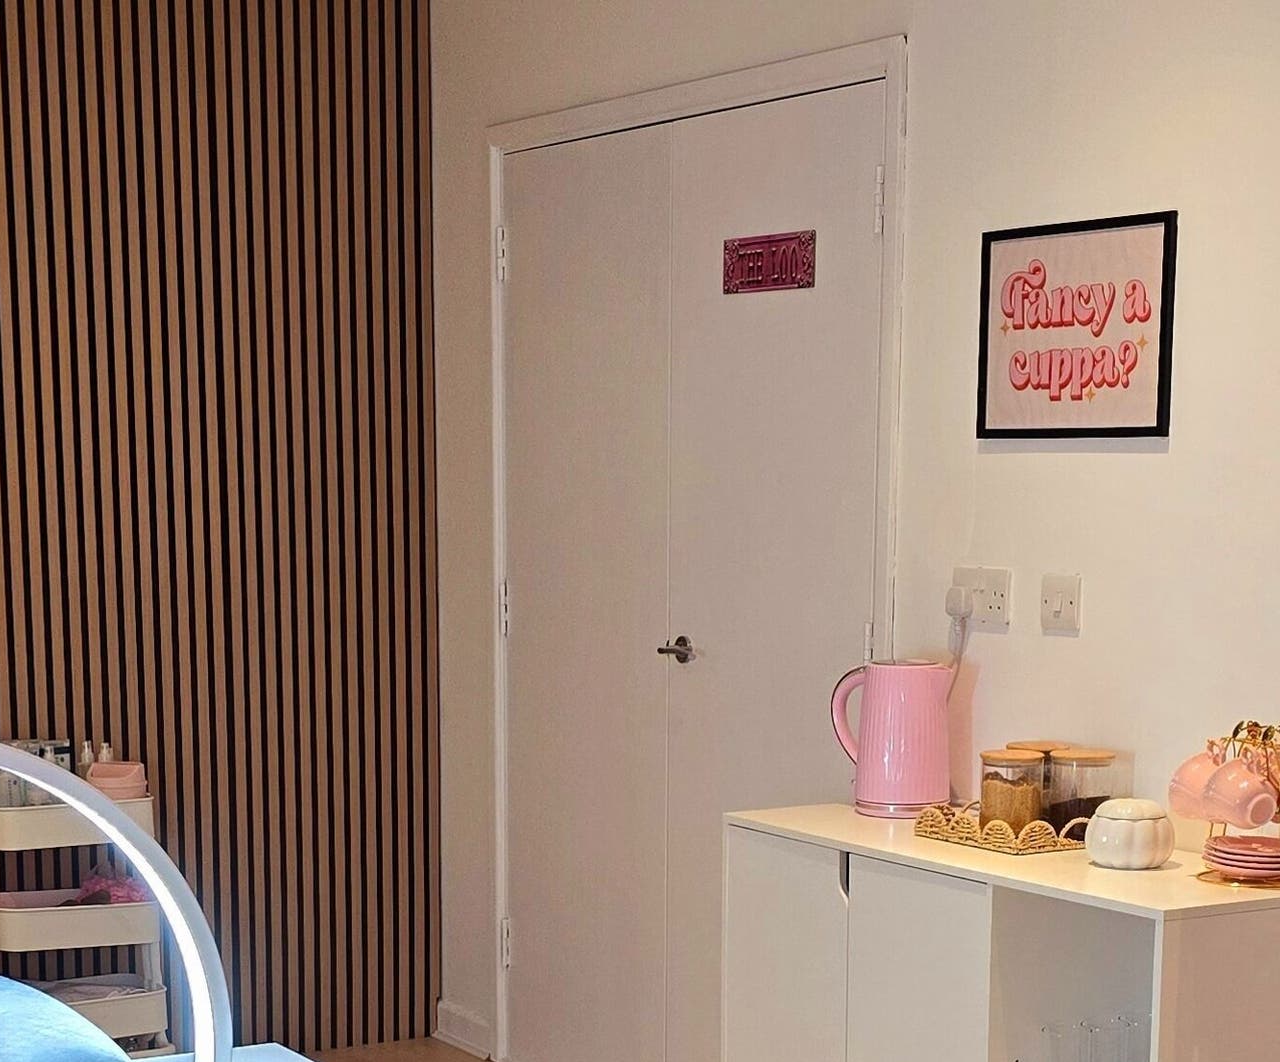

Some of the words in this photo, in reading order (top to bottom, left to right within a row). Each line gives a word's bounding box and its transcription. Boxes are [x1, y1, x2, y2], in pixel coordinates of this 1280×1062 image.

[1000, 259, 1117, 338] Fancy
[1123, 279, 1152, 323] a
[1009, 340, 1139, 402] cuppa?
